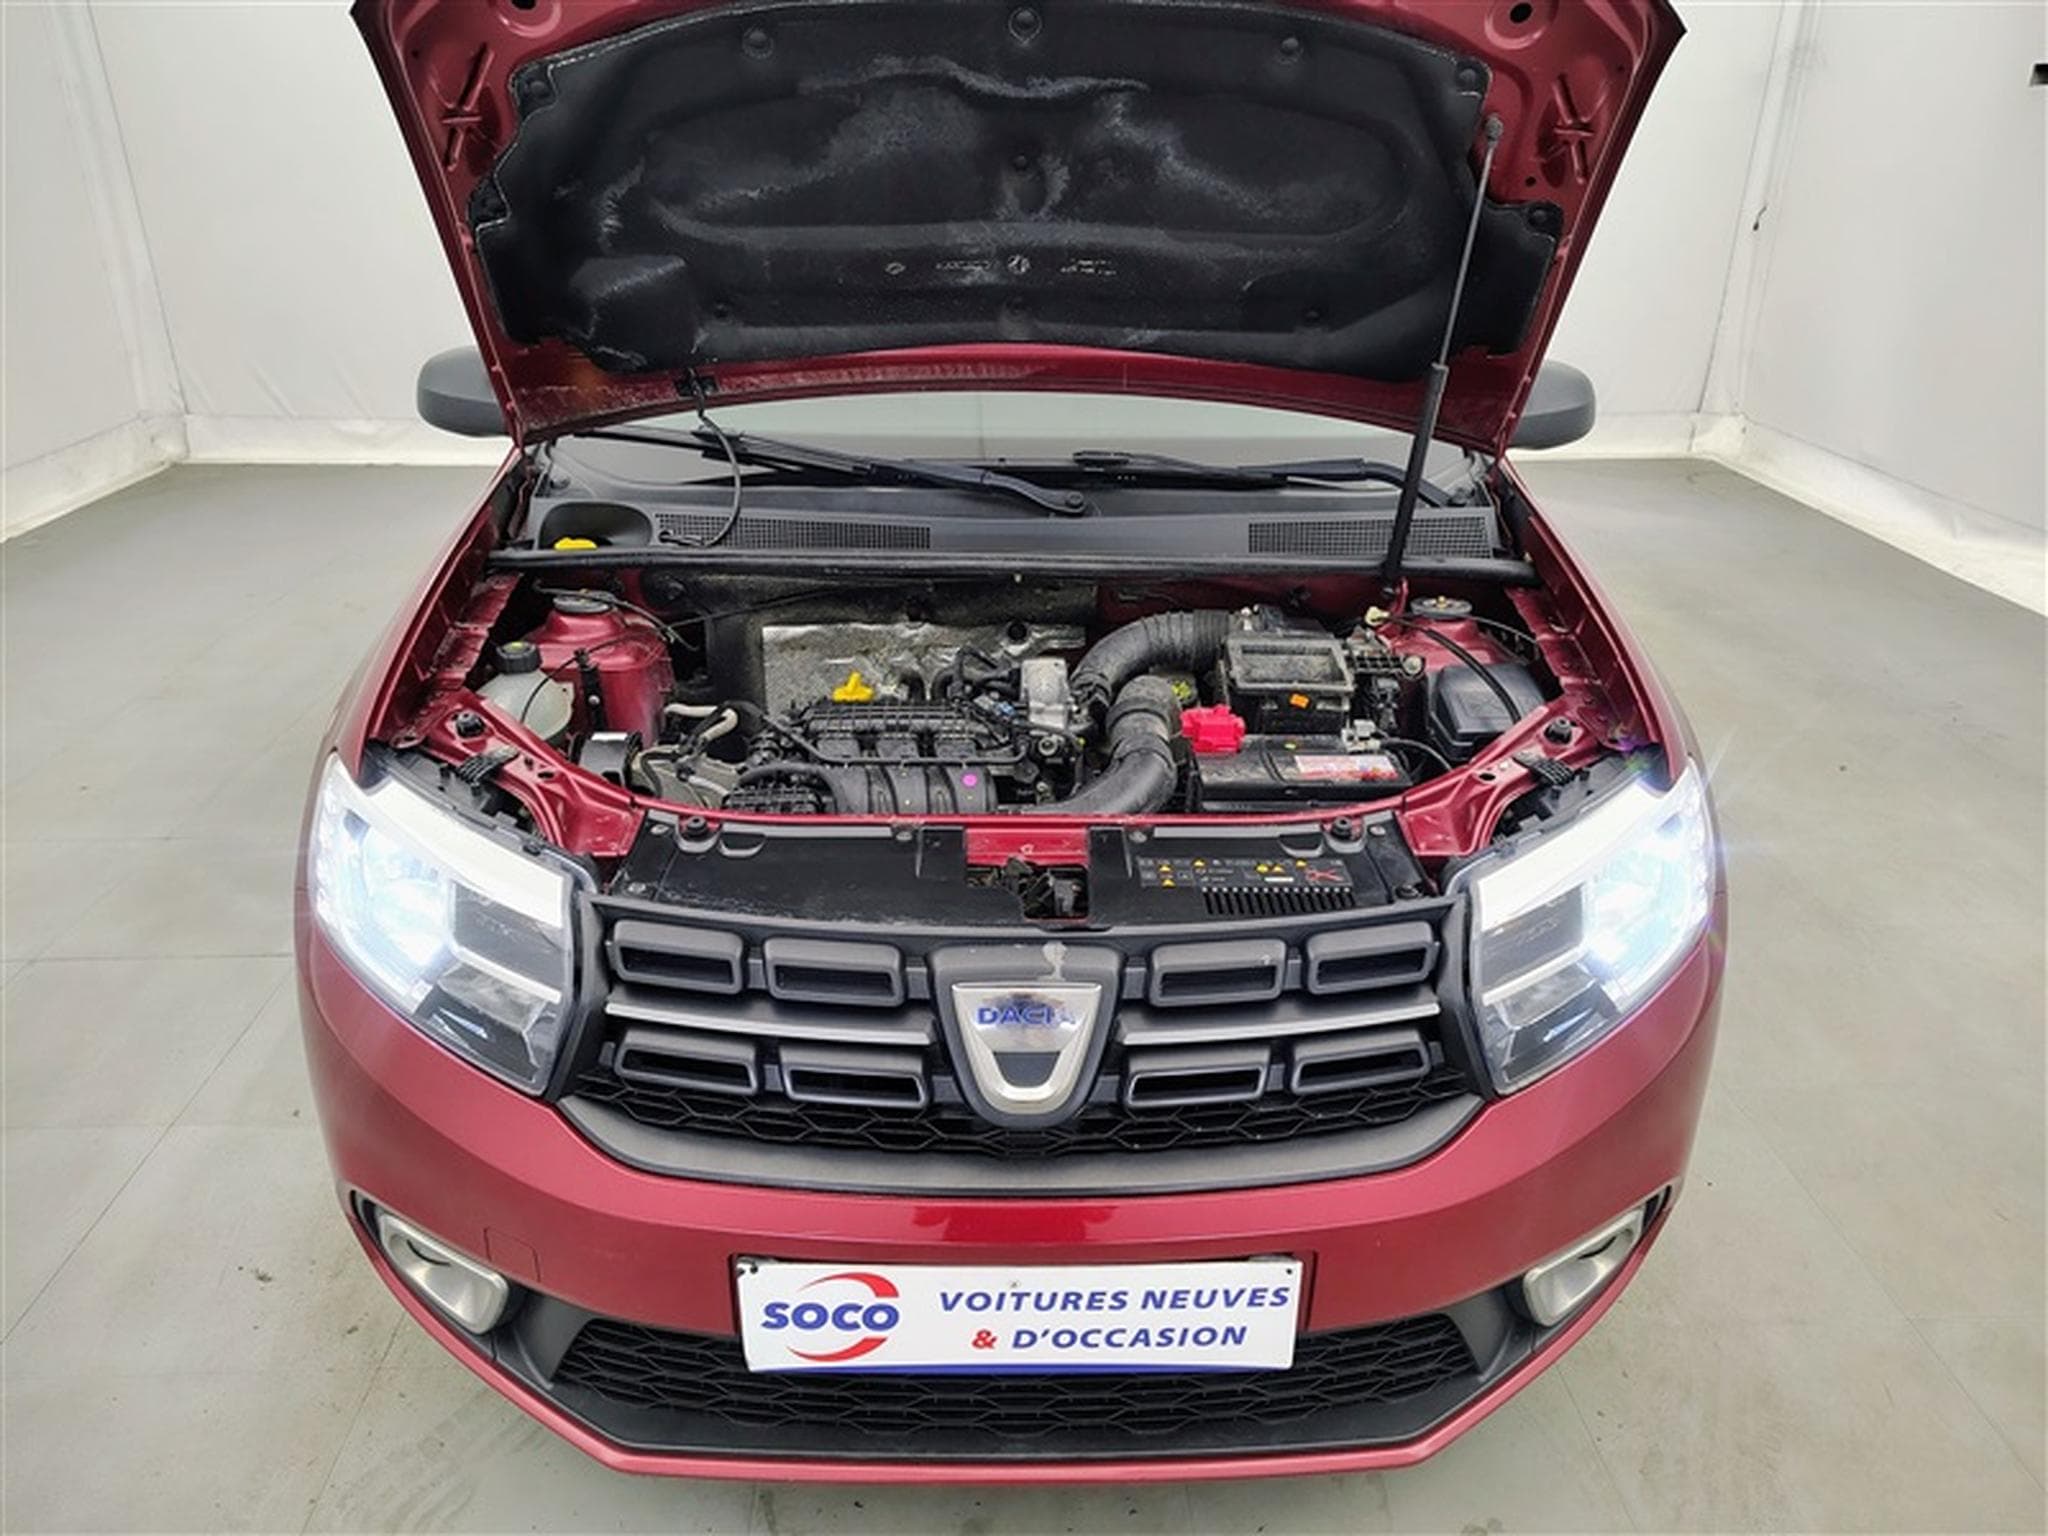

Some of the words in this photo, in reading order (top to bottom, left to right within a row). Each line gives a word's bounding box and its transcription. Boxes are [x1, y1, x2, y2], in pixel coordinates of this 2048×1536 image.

[939, 1291, 1128, 1312] VOITURES
[1140, 1287, 1290, 1310] NEUVES
[760, 1302, 900, 1331] SOCO
[971, 1329, 997, 1349] &
[1011, 1326, 1247, 1349] D’OCCASION
